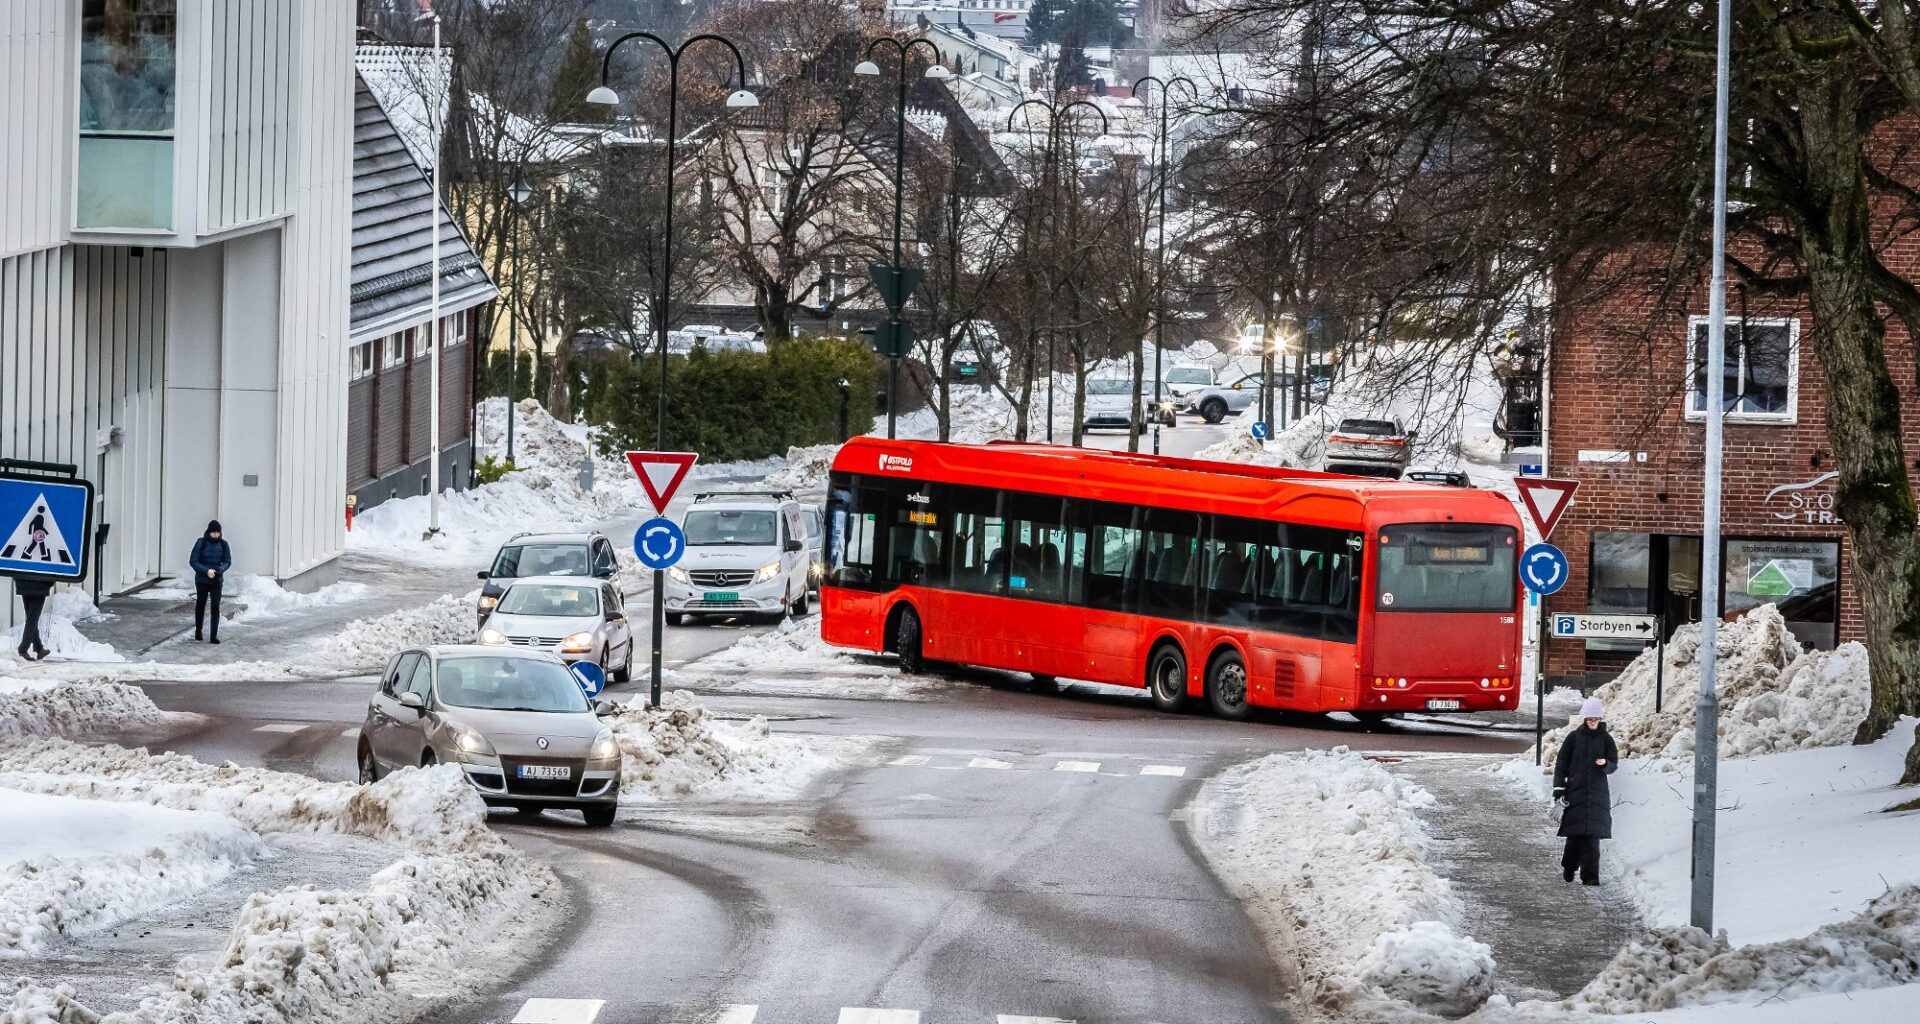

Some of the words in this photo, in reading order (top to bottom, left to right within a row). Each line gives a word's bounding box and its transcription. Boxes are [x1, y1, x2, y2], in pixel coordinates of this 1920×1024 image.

[888, 456, 912, 466] ØSTFOLD
[1742, 545, 1823, 555] stolavtrafikkskole.no
[1383, 595, 1393, 603] 70
[1500, 616, 1514, 624] 1588
[1562, 622, 1571, 633] P
[1580, 619, 1632, 633] Storbyen
[526, 766, 537, 775] AJ
[541, 767, 568, 776] 73569
